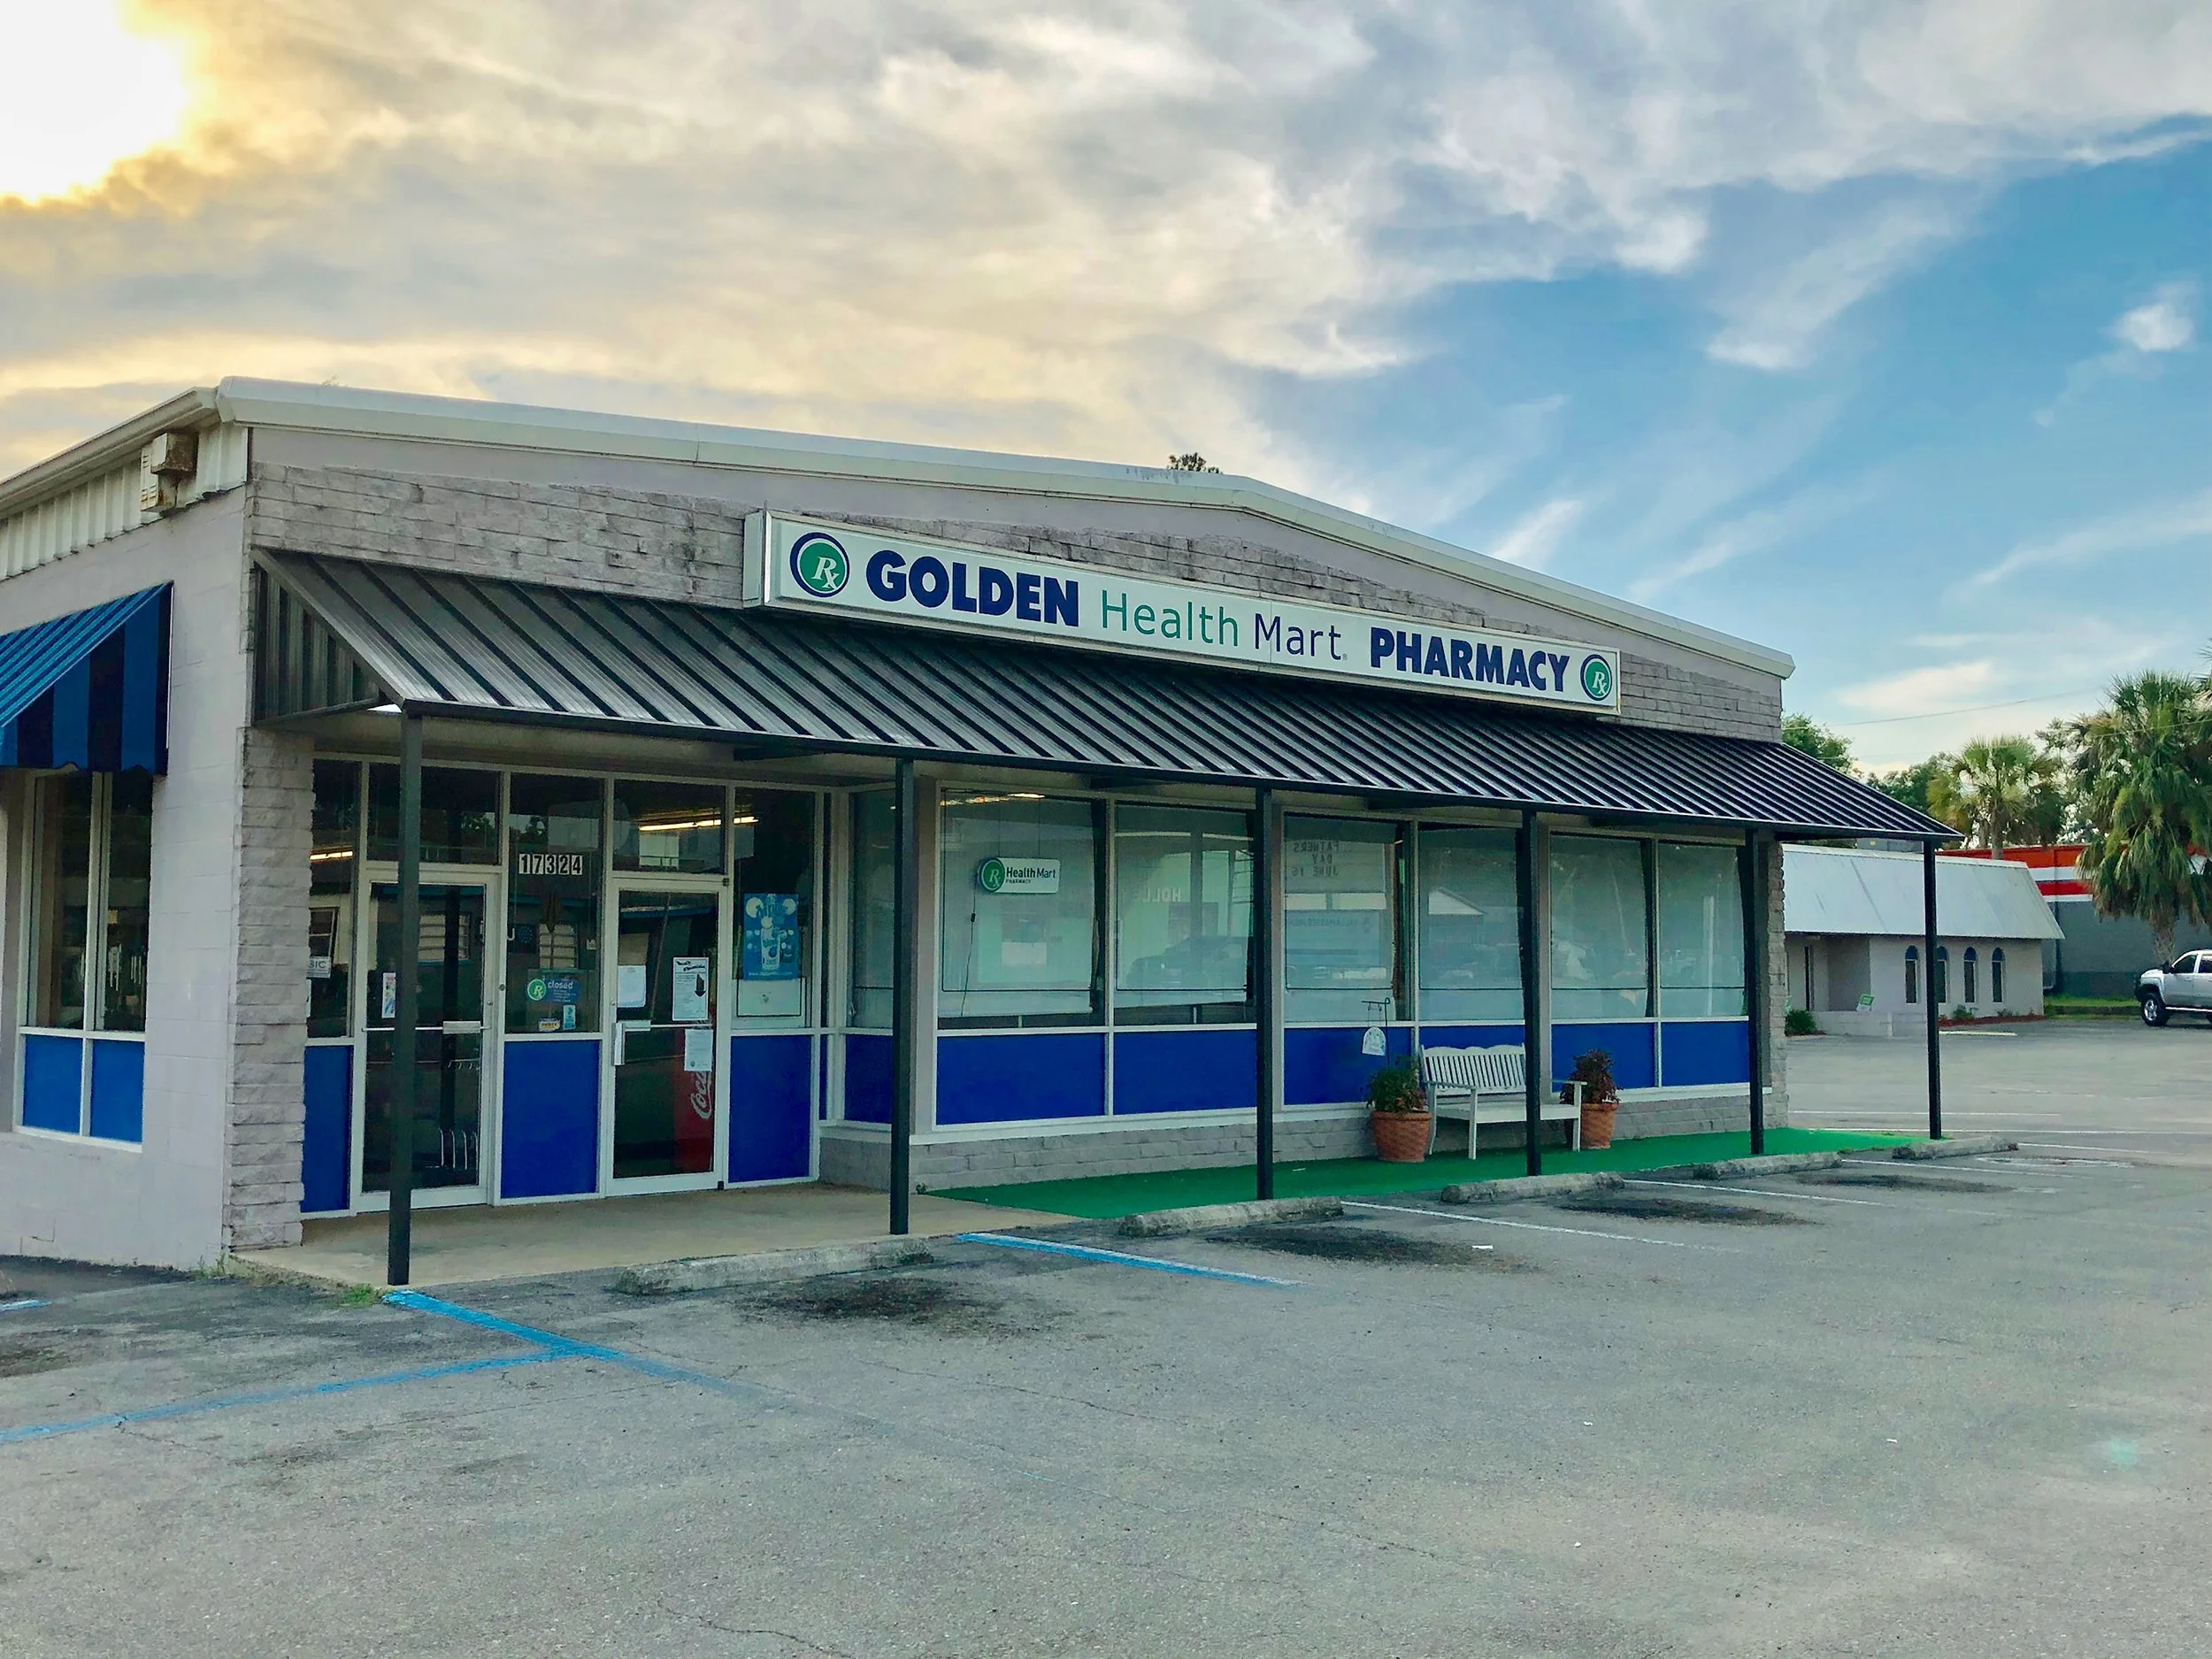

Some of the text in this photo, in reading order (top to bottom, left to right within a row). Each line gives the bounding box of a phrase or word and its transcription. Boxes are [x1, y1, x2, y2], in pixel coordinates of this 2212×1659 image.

[865, 550, 1079, 627] GOLDEN
[1102, 589, 1239, 647] Health
[1255, 612, 1341, 661] Mart
[1371, 626, 1570, 692] PHARMACY
[521, 855, 581, 874] 17324
[548, 979, 573, 989] closed
